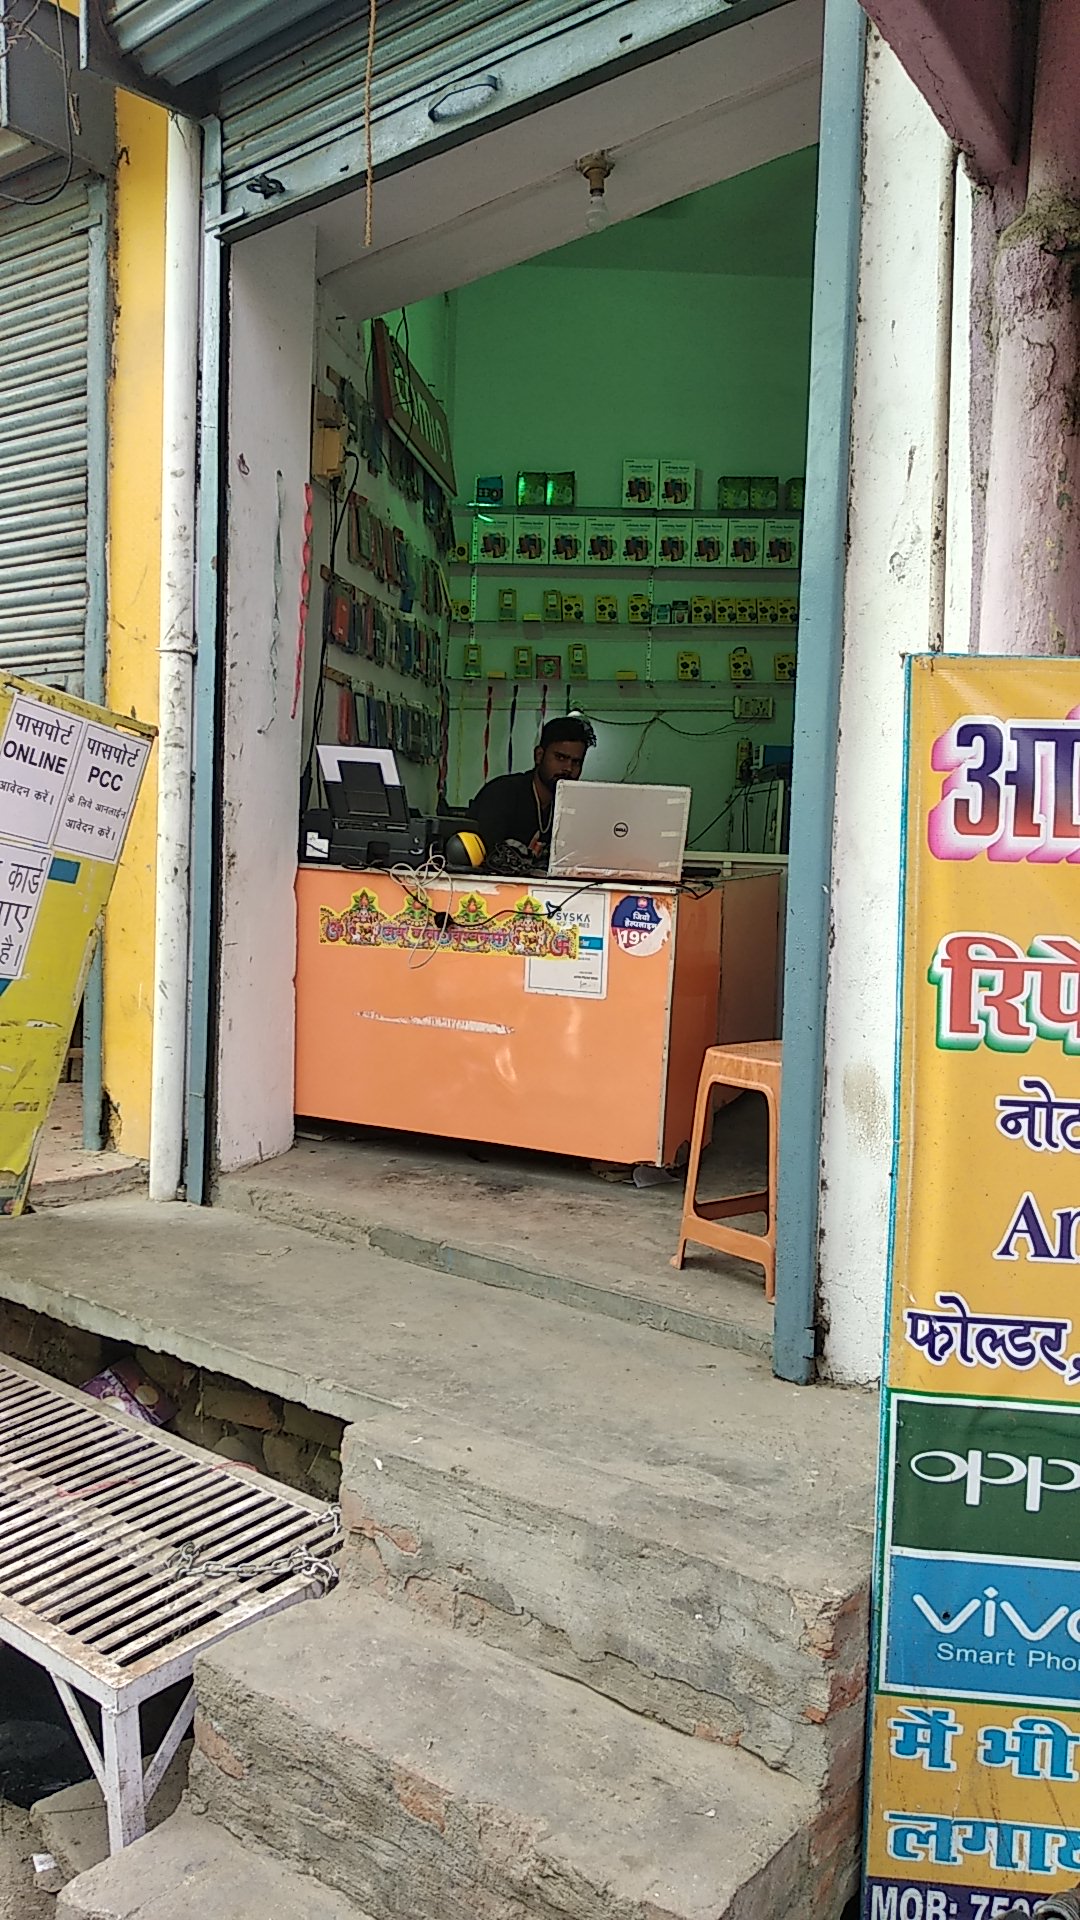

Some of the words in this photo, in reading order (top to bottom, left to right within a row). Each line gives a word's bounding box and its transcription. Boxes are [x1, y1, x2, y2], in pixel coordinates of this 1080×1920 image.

[15, 712, 76, 746] पासपोर्ट
[3, 739, 68, 776] ONLINE
[87, 735, 141, 769] पासपोर्ट
[87, 765, 124, 792] PCC
[65, 817, 95, 835] आवेदन
[555, 912, 591, 923] SYSKA
[936, 1642, 1016, 1667] Smart
[1028, 1649, 1080, 1672] Pho
[890, 1707, 961, 1770] में
